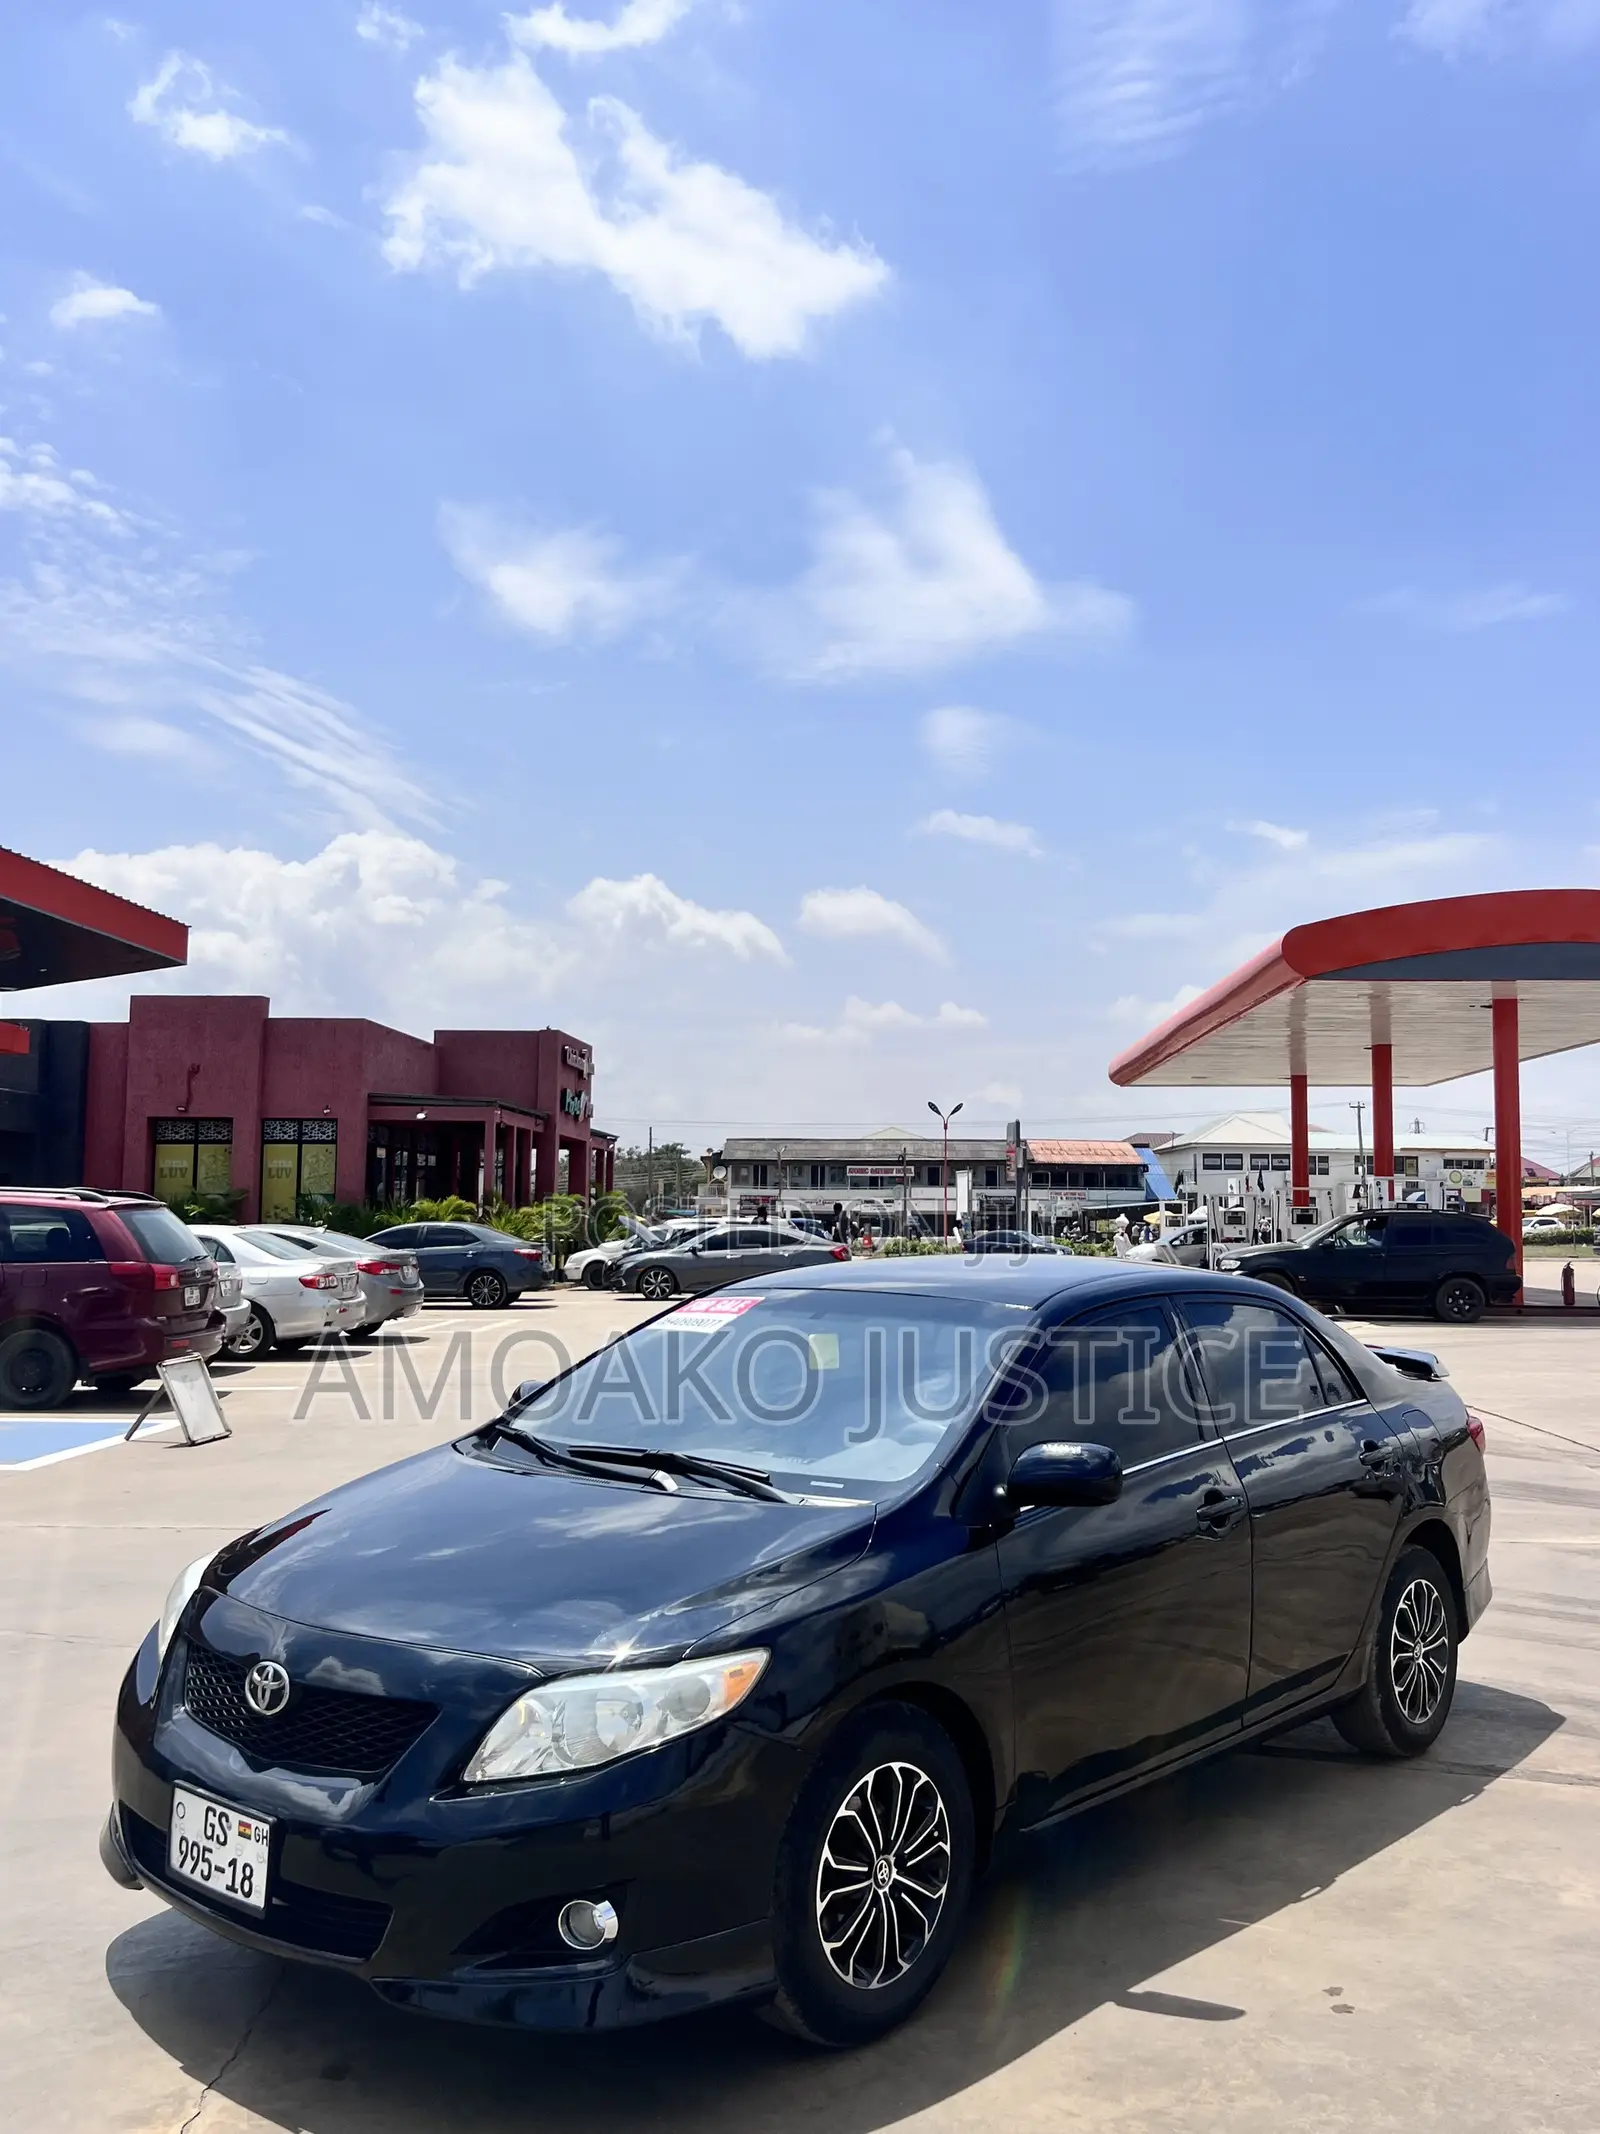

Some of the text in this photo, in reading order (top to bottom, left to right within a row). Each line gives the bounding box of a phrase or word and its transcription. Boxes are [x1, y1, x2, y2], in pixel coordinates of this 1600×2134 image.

[159, 1167, 188, 1179] LUV
[268, 1167, 292, 1179] LUV
[708, 1298, 754, 1312] SALE
[204, 1805, 269, 1847] GS GH
[178, 1835, 254, 1899] 995-18
